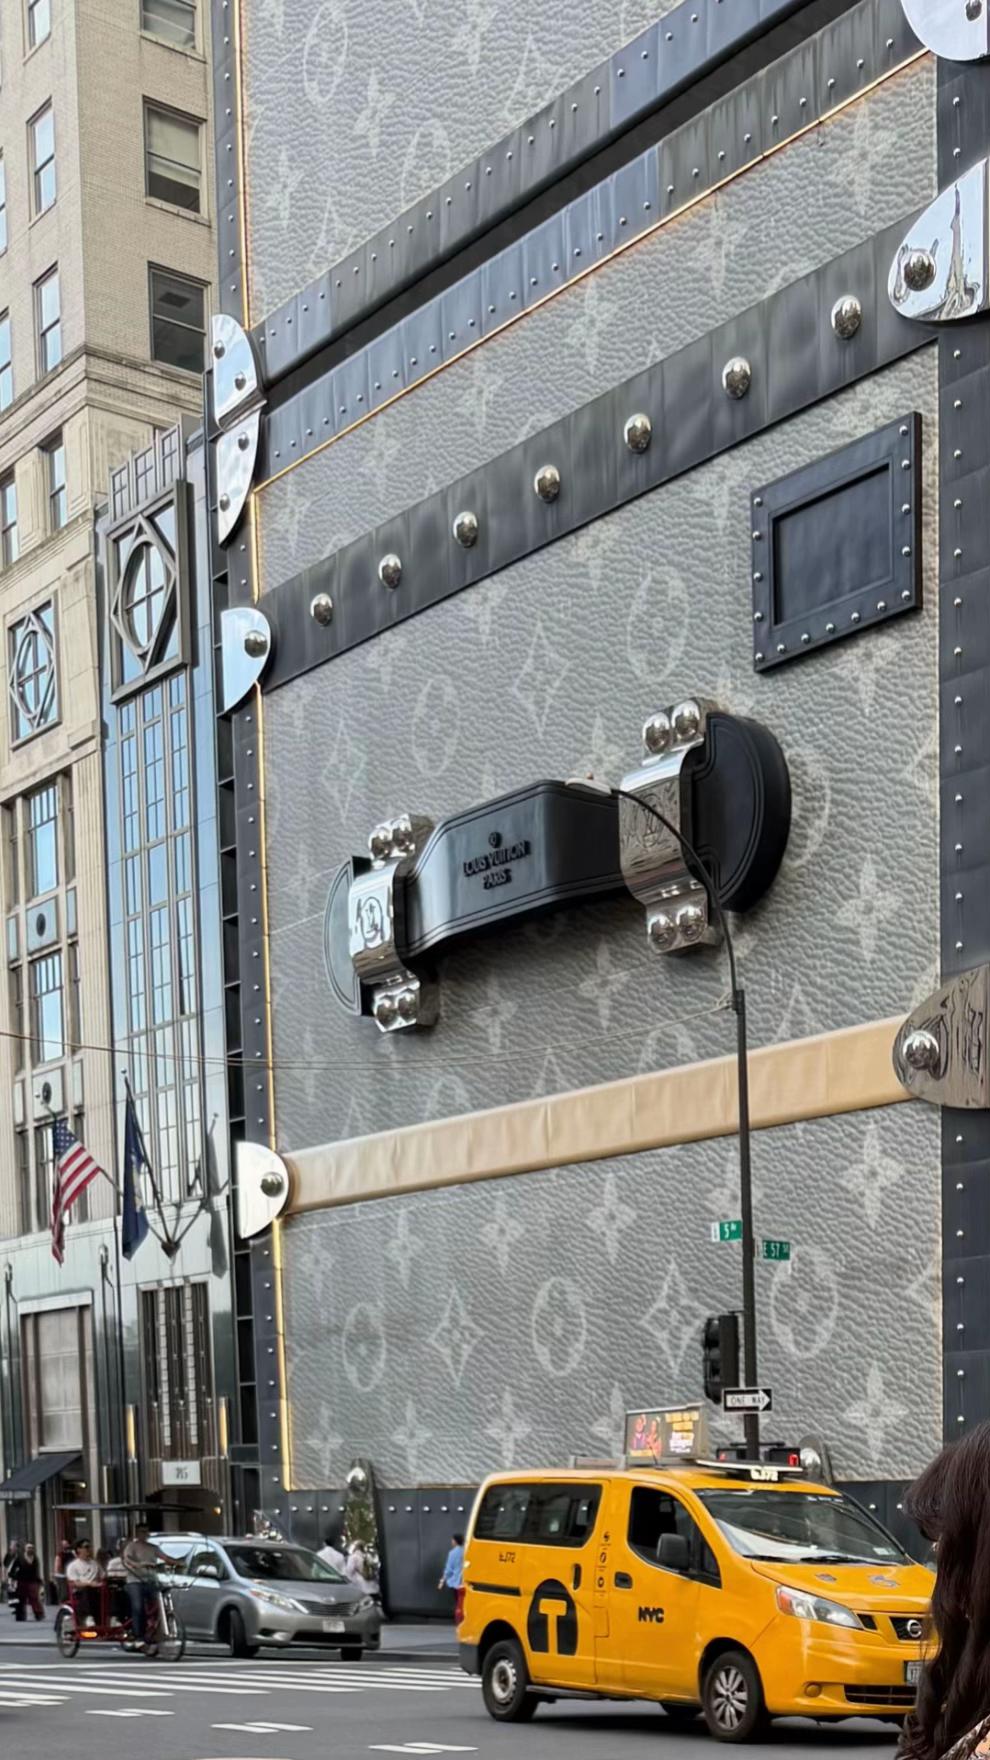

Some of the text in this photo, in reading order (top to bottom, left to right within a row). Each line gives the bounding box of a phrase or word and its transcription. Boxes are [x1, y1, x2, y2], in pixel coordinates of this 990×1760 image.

[463, 839, 532, 877] LOUIS VUITTON
[483, 868, 512, 890] PARIS
[724, 1223, 730, 1239] 5
[771, 1242, 780, 1258] 57
[730, 1395, 766, 1406] ONE WAY
[638, 1606, 664, 1623] NYC
